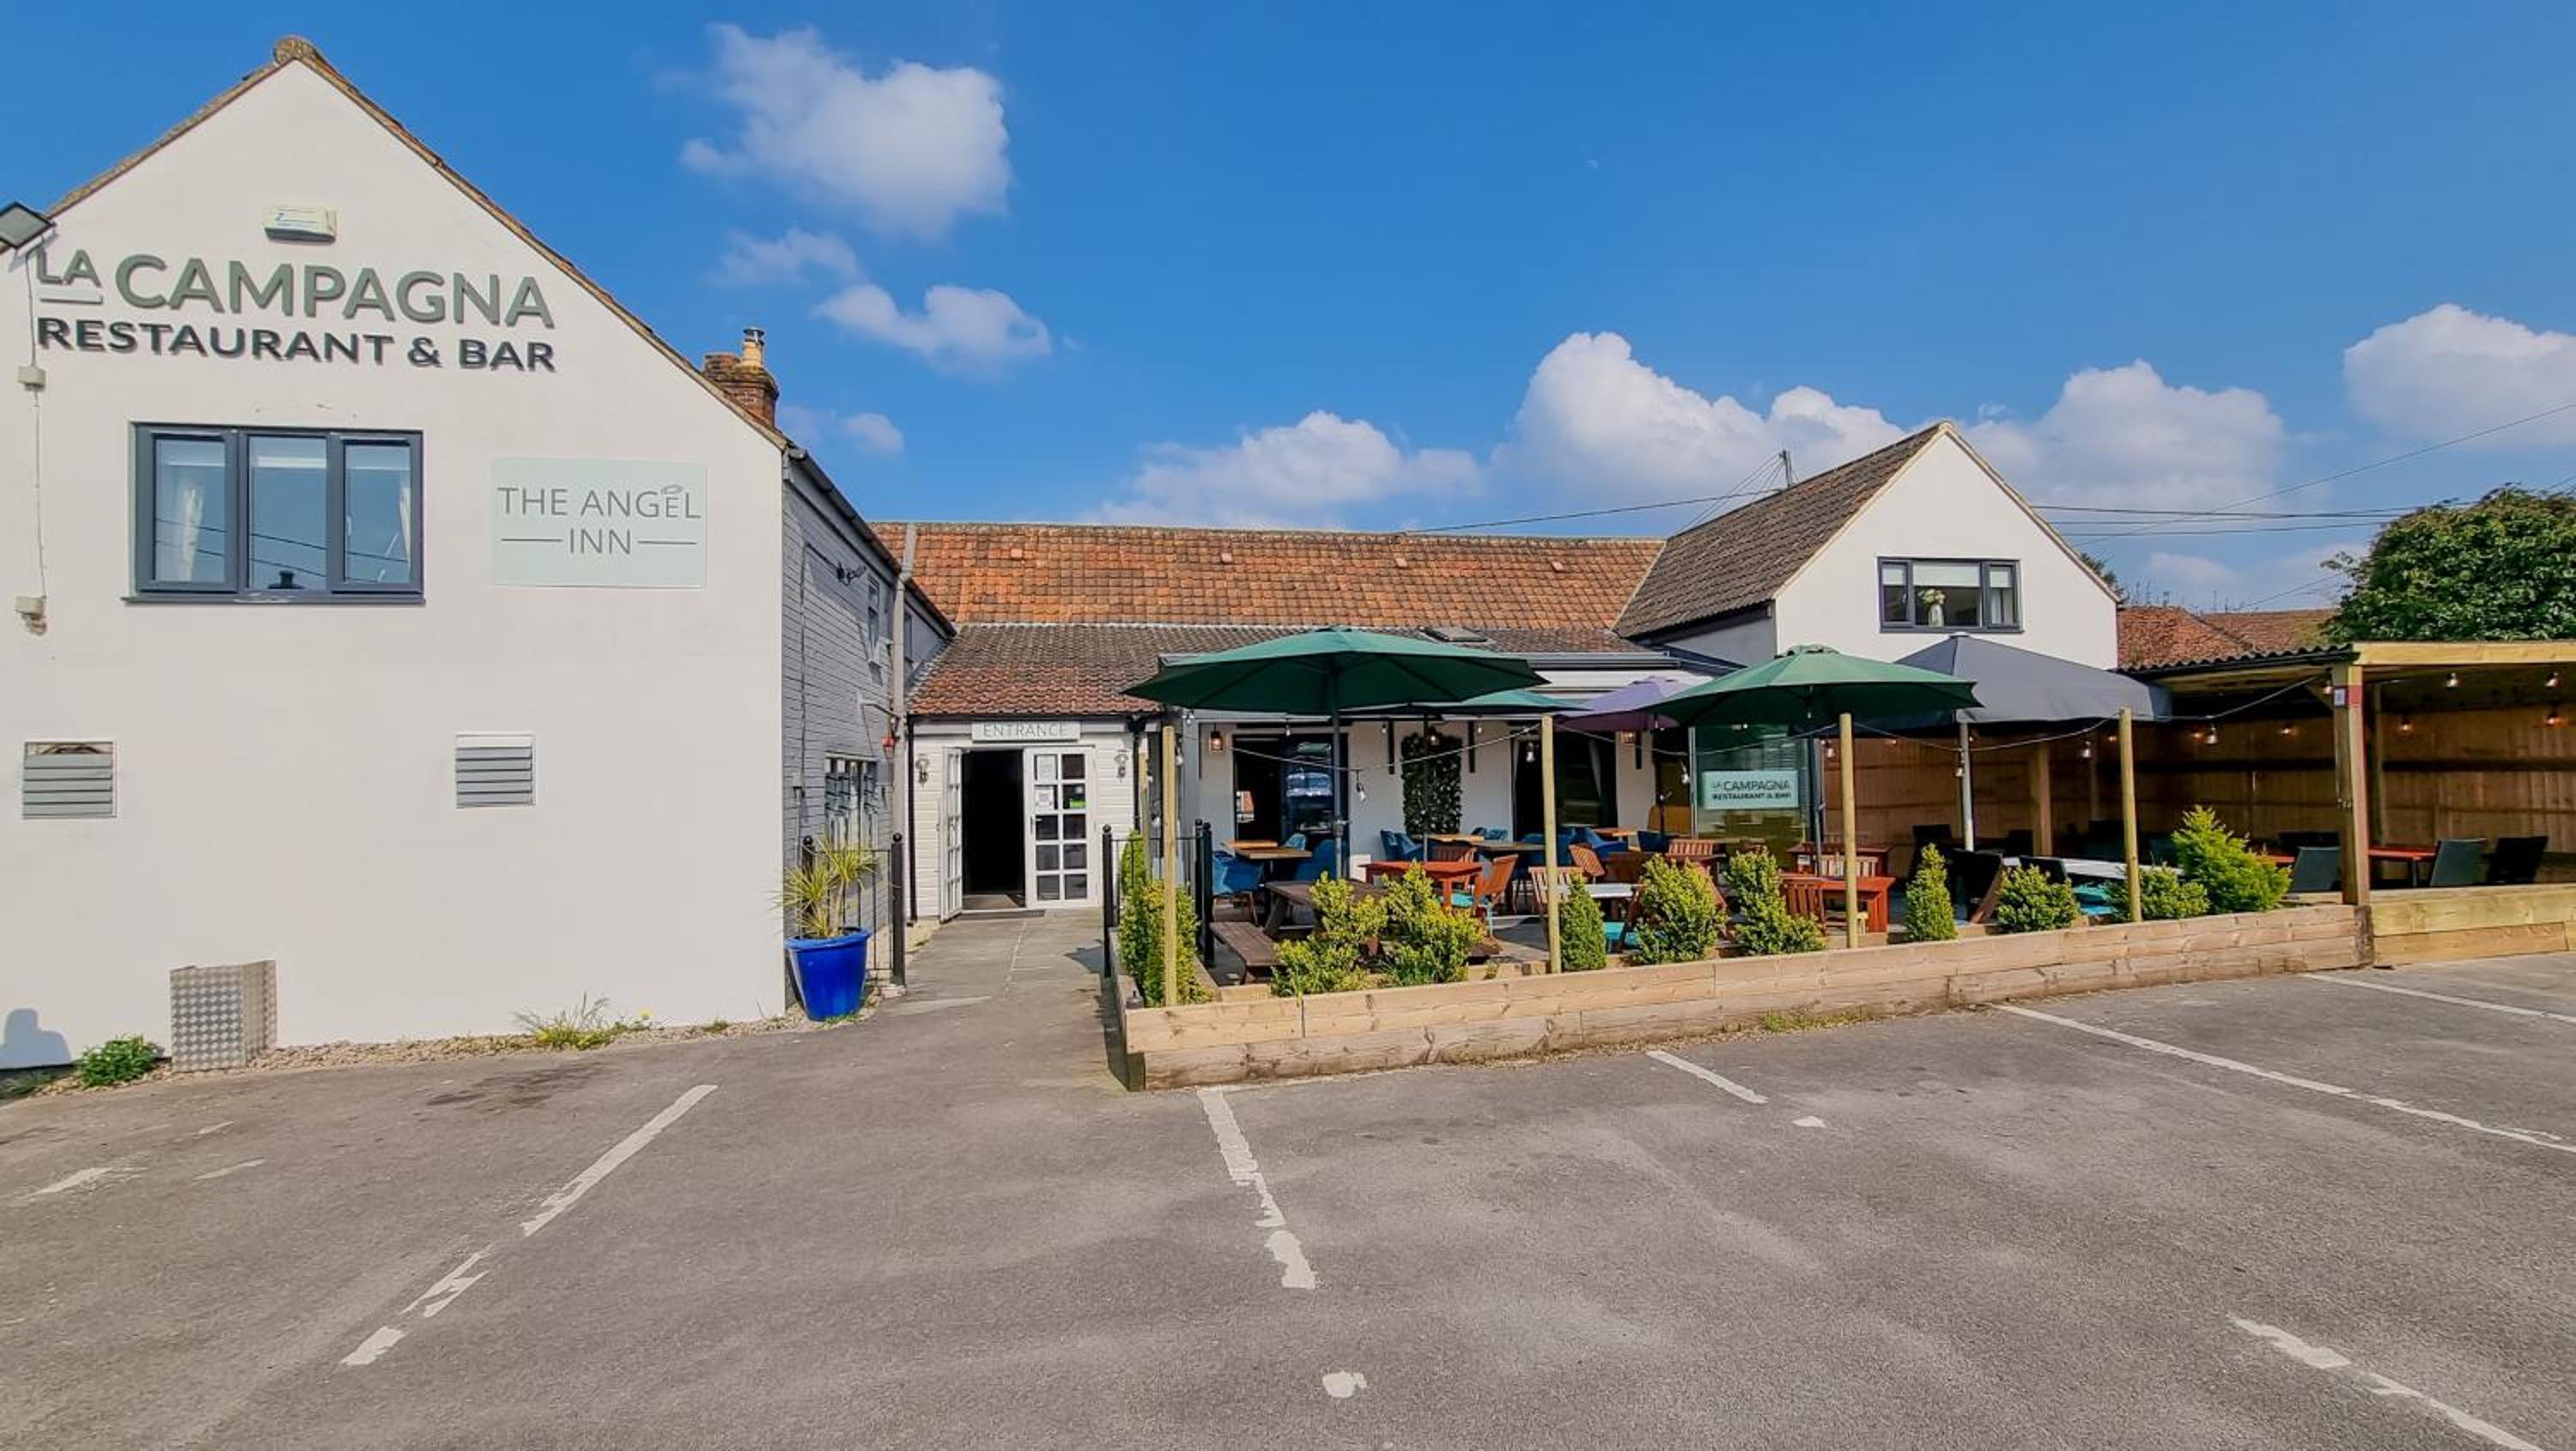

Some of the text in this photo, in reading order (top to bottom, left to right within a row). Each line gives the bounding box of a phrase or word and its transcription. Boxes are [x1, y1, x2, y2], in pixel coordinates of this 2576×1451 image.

[36, 247, 556, 329] LA CAMPAGNA
[37, 317, 556, 373] RESTAURANT & BAR
[497, 484, 702, 519] THE ANGEL
[569, 527, 631, 555] INN
[982, 722, 1070, 737] ENTRANCE
[1723, 780, 1791, 791] CAMPAGNA
